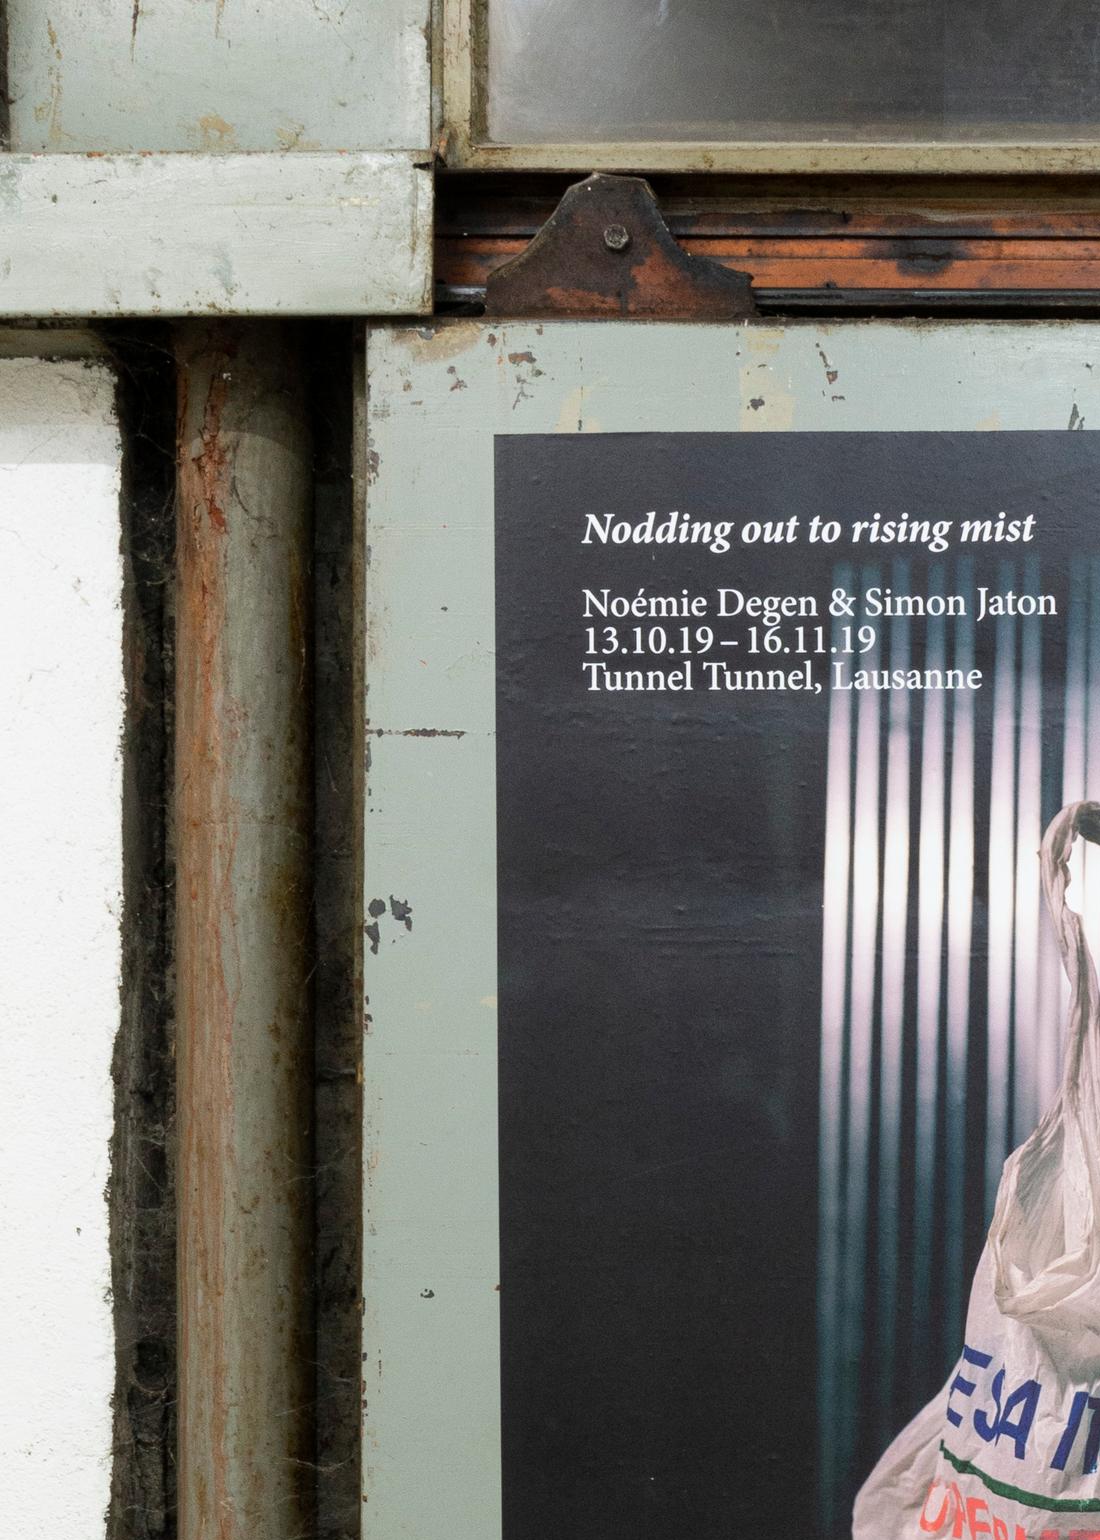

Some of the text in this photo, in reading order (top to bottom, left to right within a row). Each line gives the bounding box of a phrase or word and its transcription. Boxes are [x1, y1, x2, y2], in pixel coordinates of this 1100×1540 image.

[580, 511, 1037, 554] Nodding out to rising mist
[582, 587, 1058, 625] Noémie Degen & Simon Jaton
[585, 626, 714, 654] 13.10.19
[748, 625, 876, 654] 16.11.19
[582, 660, 983, 694] Tunnel Tunnel, Lausanne
